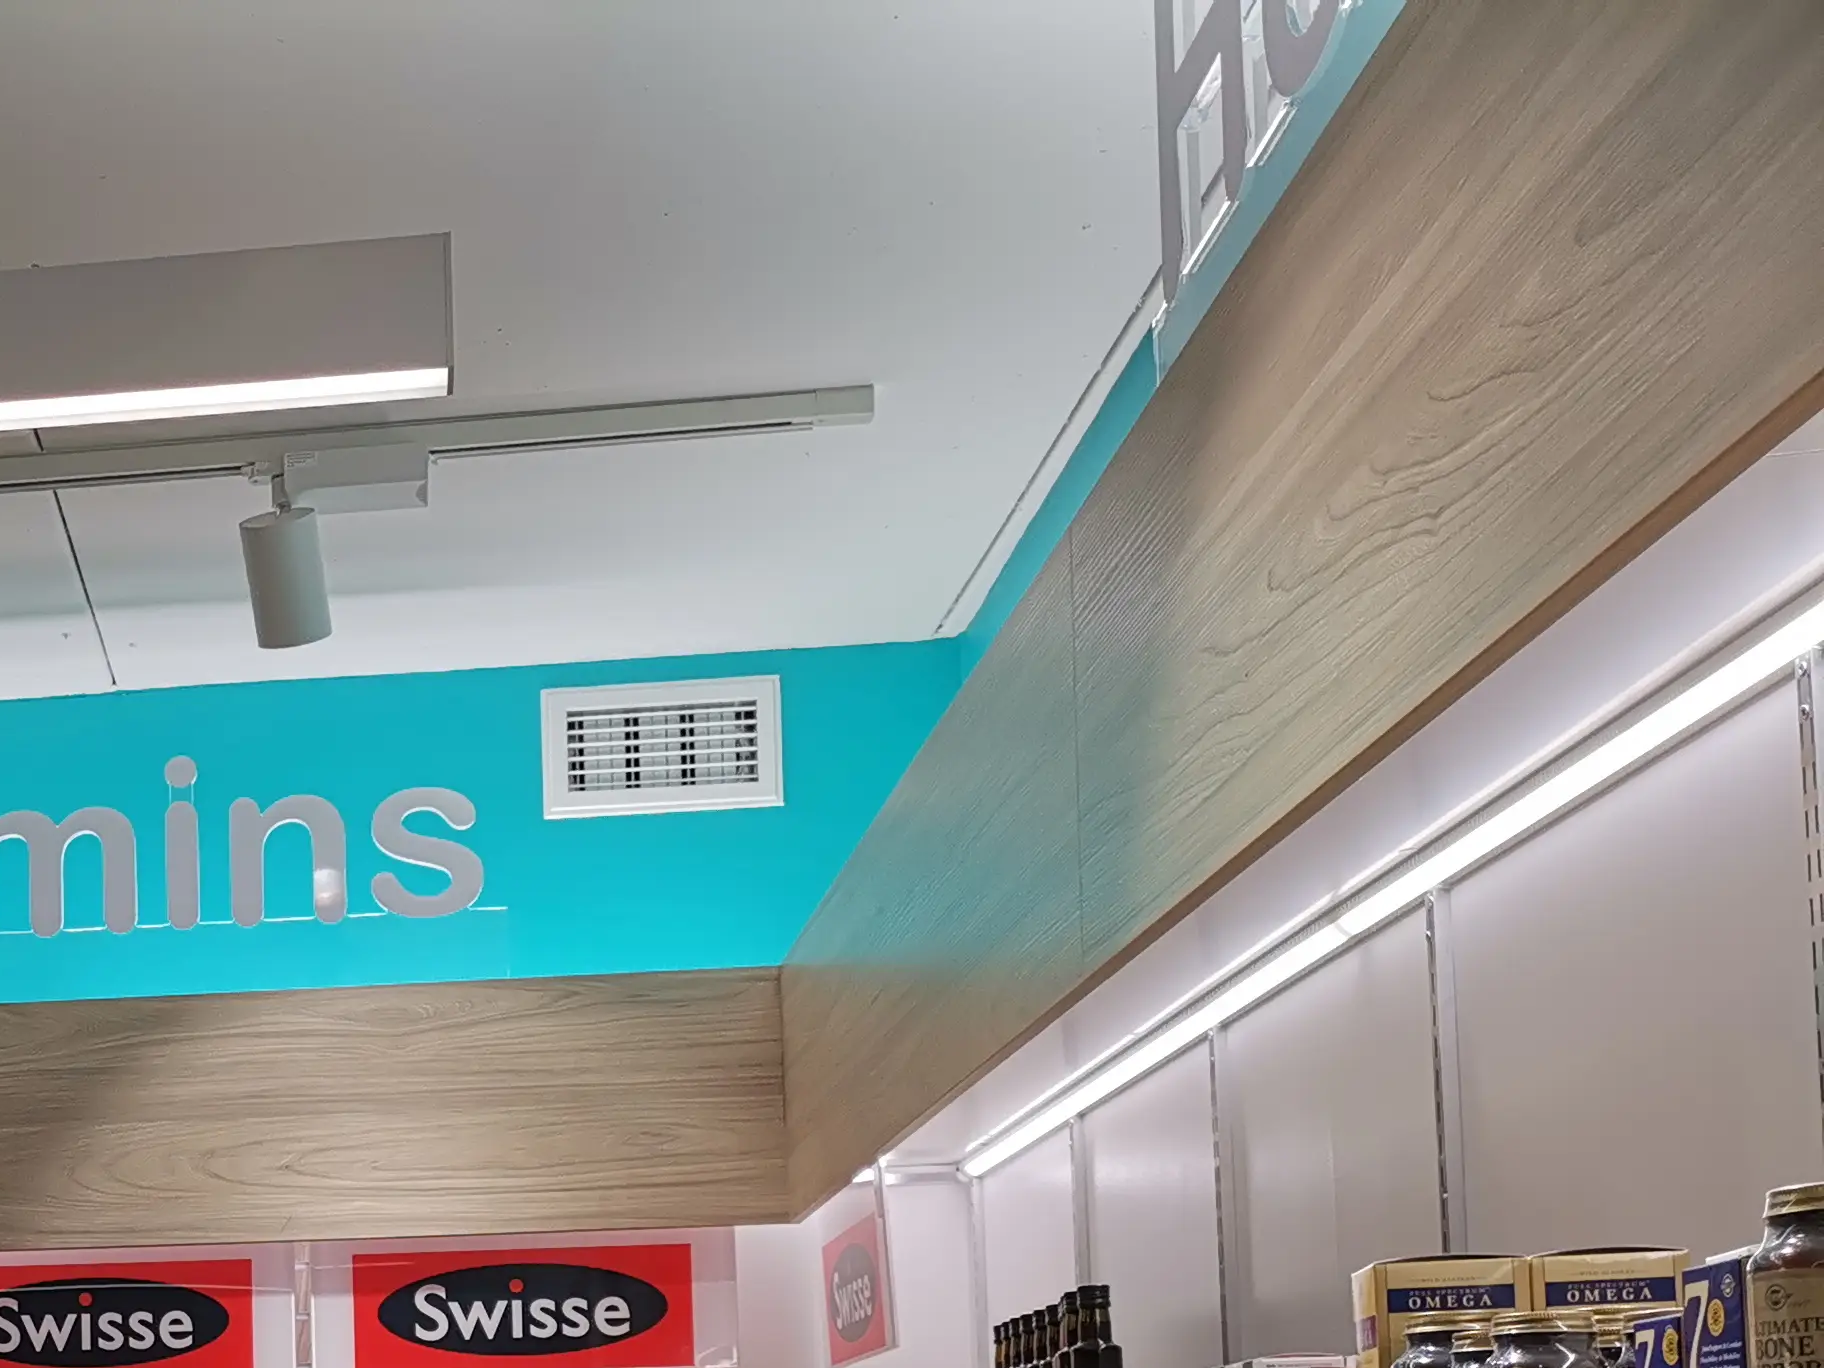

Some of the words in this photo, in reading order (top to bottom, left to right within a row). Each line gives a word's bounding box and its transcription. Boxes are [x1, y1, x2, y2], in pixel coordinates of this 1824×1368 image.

[832, 1271, 873, 1331] Swisse
[1408, 1294, 1493, 1310] OMEGA
[1566, 1286, 1654, 1303] OMEGA
[414, 1278, 630, 1343] Swisse
[1755, 1336, 1815, 1357] BONE
